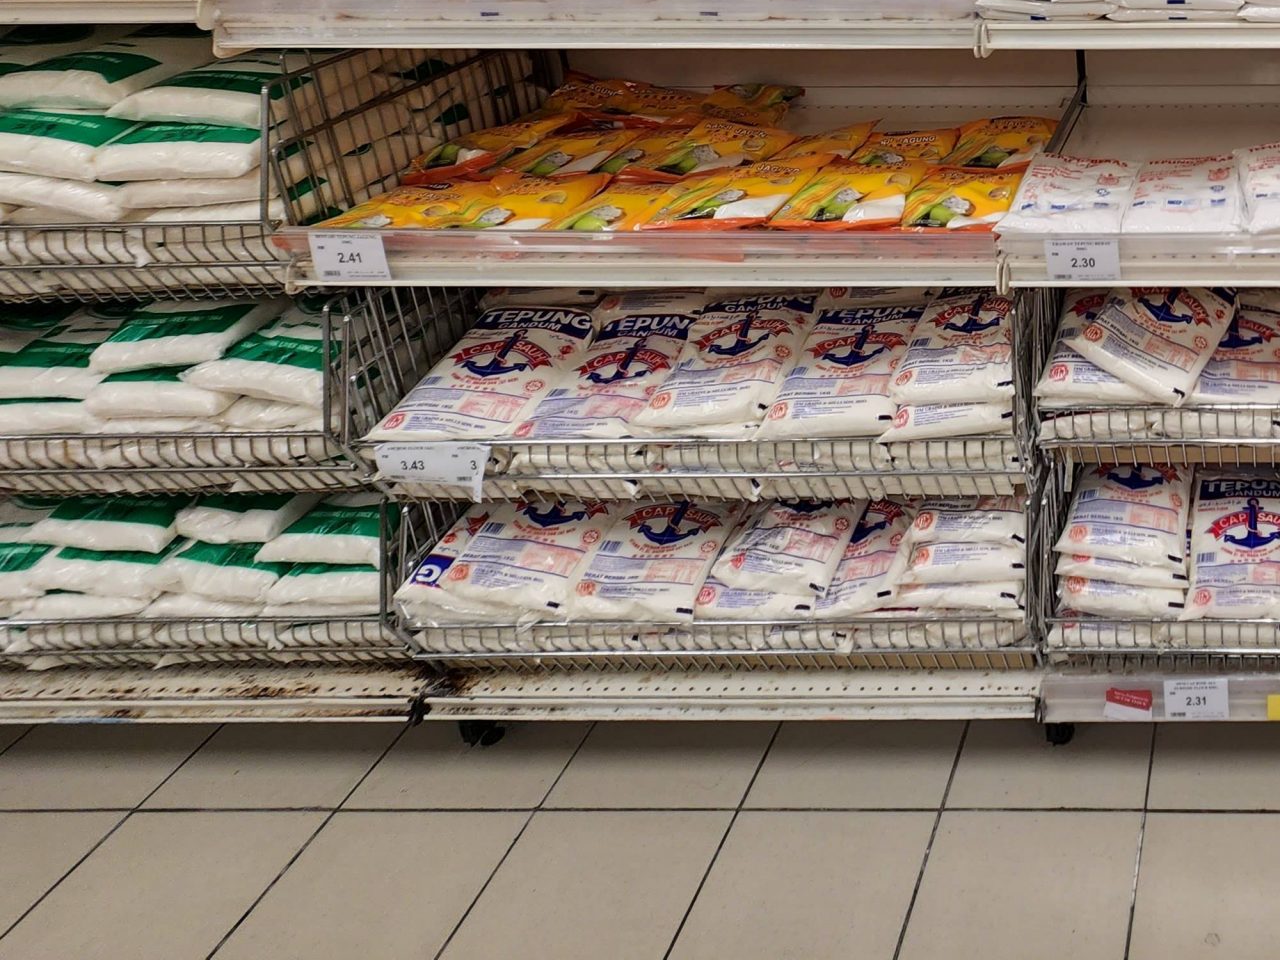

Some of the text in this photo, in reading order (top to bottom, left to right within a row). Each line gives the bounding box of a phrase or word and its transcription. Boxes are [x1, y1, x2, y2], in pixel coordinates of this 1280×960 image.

[338, 253, 362, 264] 2.41
[1070, 257, 1096, 269] 2.30
[725, 301, 788, 312] GANDUM
[943, 303, 974, 318] CAP
[485, 310, 590, 329] TEPUNG
[841, 313, 904, 325] GANDUM
[499, 322, 561, 331] GANDUM
[710, 319, 787, 339] CAP SAUH
[618, 328, 677, 338] GANDUM
[824, 336, 853, 348] CAP
[470, 341, 548, 365] CAP SAUH
[593, 351, 670, 368] CAP SAUH
[400, 460, 425, 470] 3.43
[641, 507, 720, 523] CAP SAUH
[871, 502, 901, 517] SAUH
[1220, 514, 1247, 527] CAP
[1186, 697, 1207, 706] 2.31
